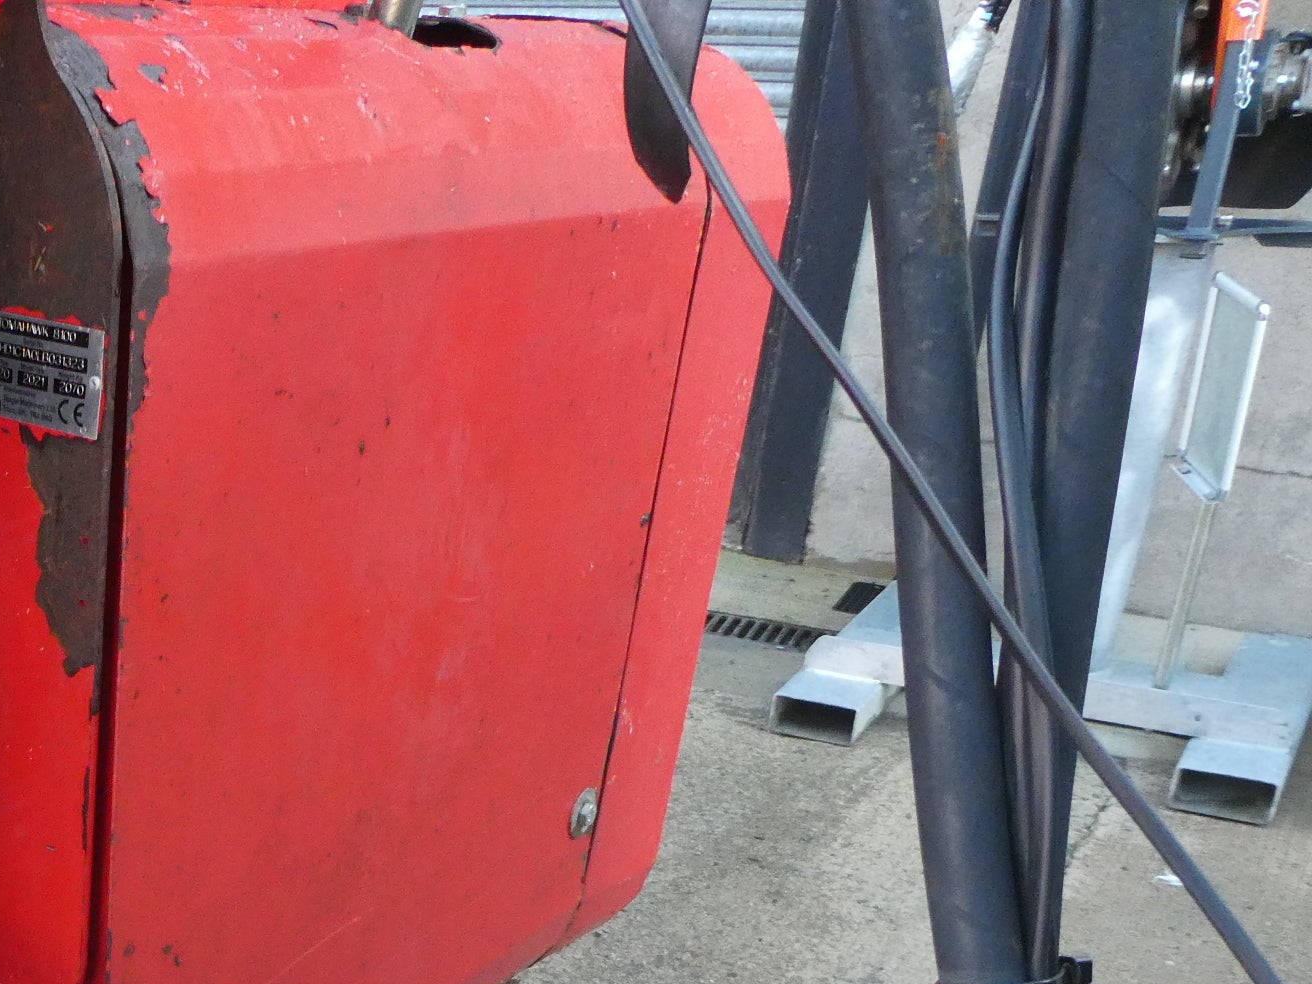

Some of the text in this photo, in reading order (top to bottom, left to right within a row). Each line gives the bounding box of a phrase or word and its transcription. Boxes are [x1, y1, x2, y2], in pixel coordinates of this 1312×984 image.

[0, 317, 49, 338] TOMAHAWK
[53, 328, 77, 343] 8100
[22, 373, 45, 386] 2021
[59, 381, 85, 396] 2070
[58, 399, 85, 428] CE
